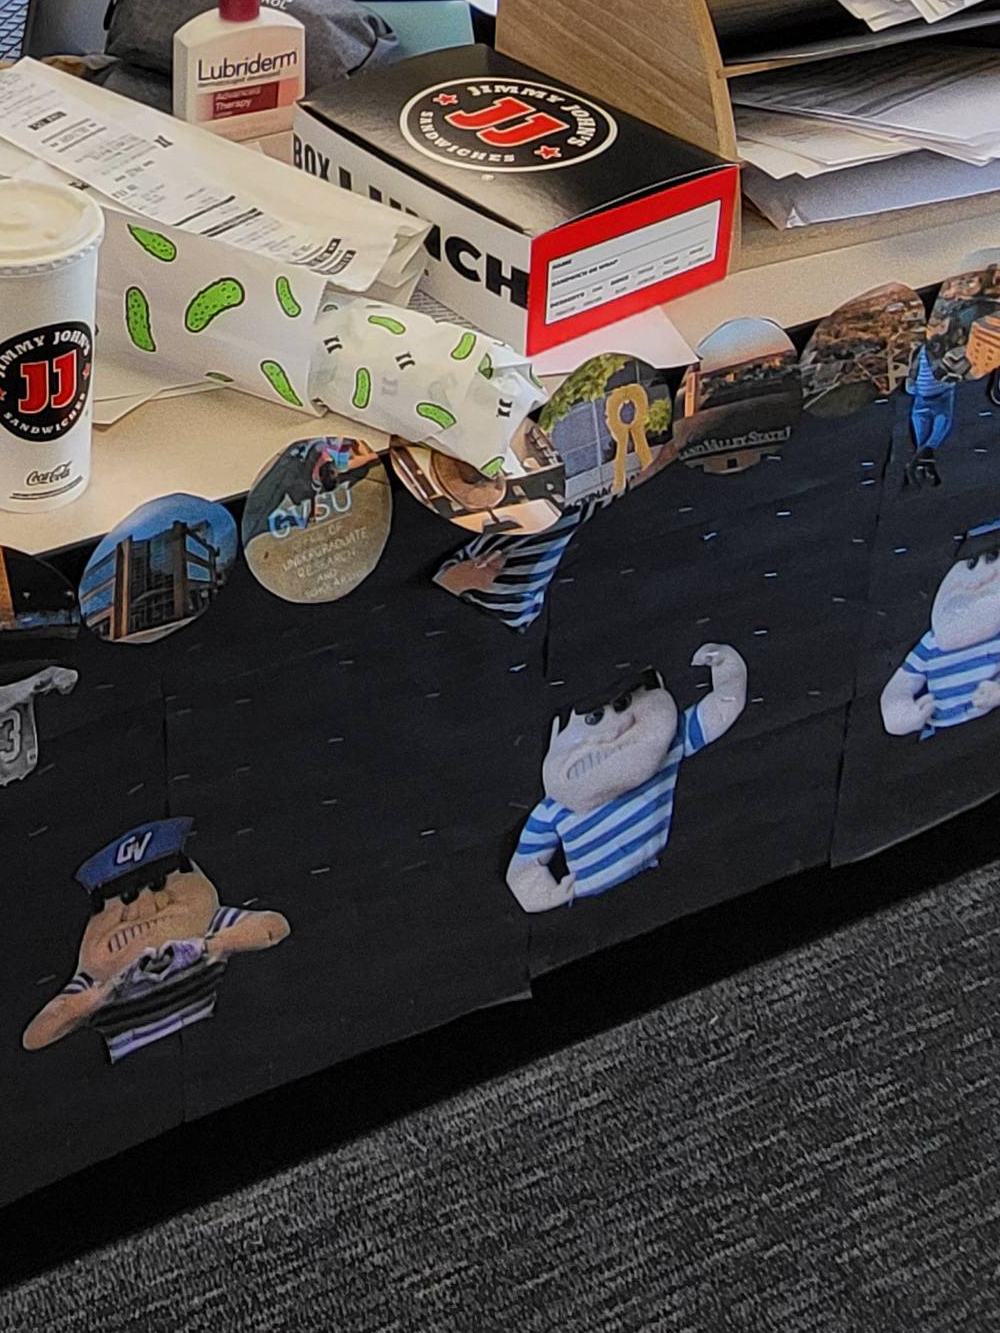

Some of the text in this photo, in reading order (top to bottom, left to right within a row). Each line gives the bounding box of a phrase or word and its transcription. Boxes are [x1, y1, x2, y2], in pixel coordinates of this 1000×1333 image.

[198, 50, 297, 81] Lubriderm
[215, 98, 253, 112] Therapy
[444, 95, 570, 148] JJ
[466, 83, 598, 148] JIMMY JOHN'S
[293, 133, 331, 182] BOX
[419, 110, 516, 164] SANDWICHES
[51, 329, 92, 357] JOHN'S
[18, 348, 79, 415] JJ
[2, 391, 87, 435] SANDWICHES
[267, 481, 353, 539] GVSU
[114, 830, 153, 866] GV
